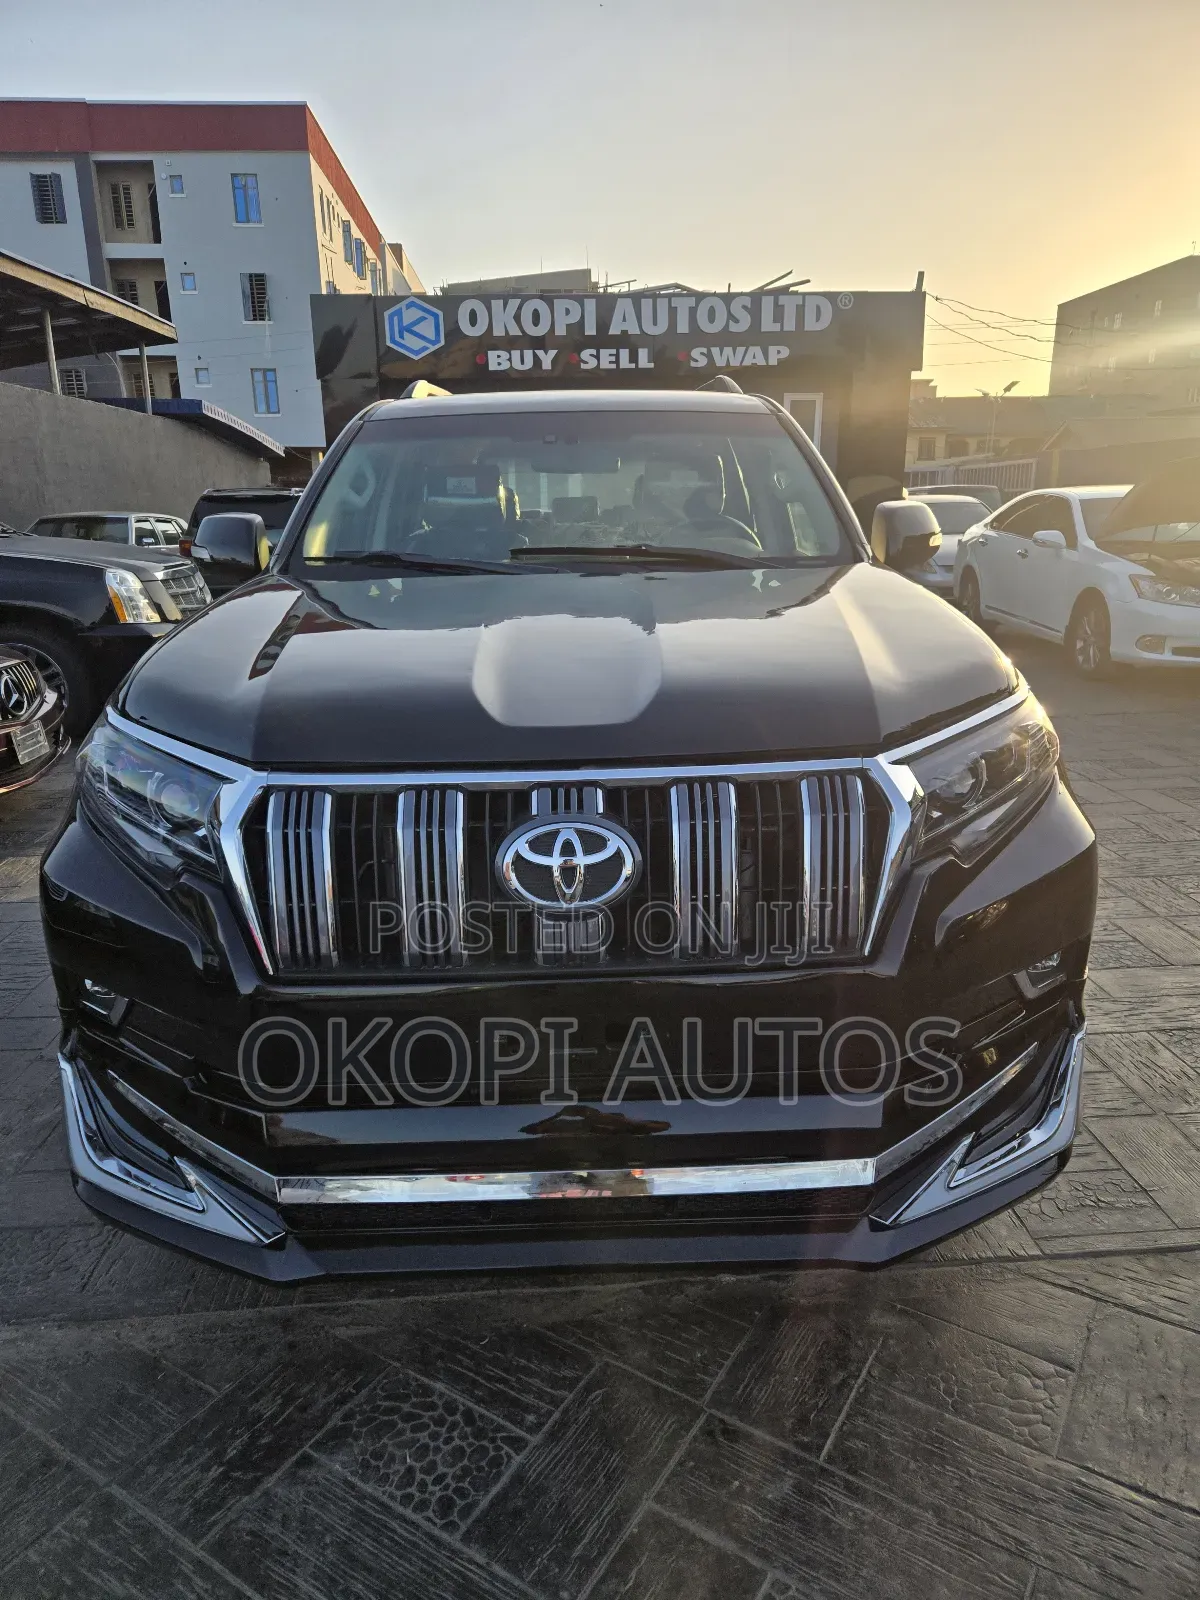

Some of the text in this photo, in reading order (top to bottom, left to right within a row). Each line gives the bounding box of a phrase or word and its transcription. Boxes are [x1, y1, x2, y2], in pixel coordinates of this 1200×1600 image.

[457, 298, 597, 337] OKOPI
[608, 295, 752, 336] AUTOS
[487, 345, 790, 371] BUY SELL SWAP
